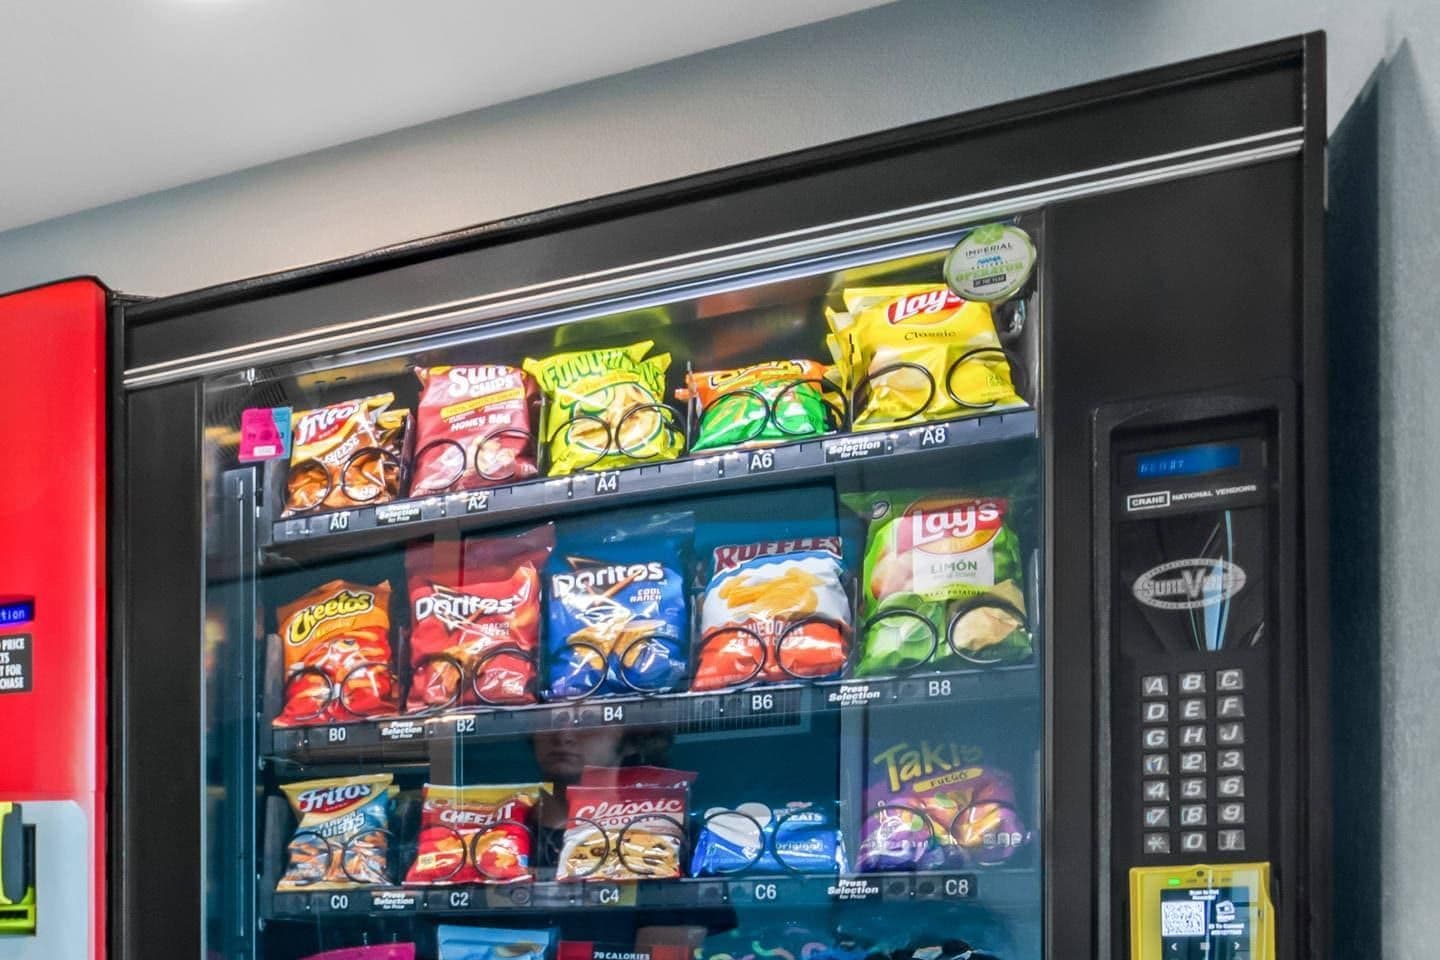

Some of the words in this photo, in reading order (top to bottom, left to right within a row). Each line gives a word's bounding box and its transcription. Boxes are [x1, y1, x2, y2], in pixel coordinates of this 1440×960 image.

[965, 242, 1013, 258] IMPERIAL
[922, 428, 945, 443] A8
[750, 454, 772, 469] A6
[598, 477, 617, 491] A4
[467, 496, 487, 510] A2
[1131, 494, 1166, 507] CRANE
[1171, 490, 1214, 502] NATIONAL
[1215, 484, 1258, 497] VENDORS
[330, 513, 348, 530] A0
[912, 500, 1001, 548] Lay's
[713, 537, 843, 576] RUFFLES
[929, 558, 978, 575] LIMÓN
[552, 562, 665, 599] Doritos
[415, 596, 514, 621] Doritos
[288, 590, 375, 647] Cheetos
[2, 638, 25, 651] PRICE
[5, 663, 22, 677] FOR
[928, 681, 951, 696] B8
[1147, 678, 1163, 693] A
[1183, 674, 1201, 690] B
[1221, 671, 1239, 687] C
[752, 695, 772, 709] B6
[829, 690, 880, 701] Selection
[604, 708, 622, 721] B4
[1147, 704, 1165, 720] D
[1185, 701, 1201, 717] E
[1222, 698, 1238, 714] F
[457, 719, 474, 732] B2
[329, 728, 346, 741] B0
[1146, 730, 1165, 746] G
[1184, 727, 1203, 743] H
[1220, 725, 1238, 741] J
[1187, 754, 1202, 769] 2
[1223, 752, 1240, 767] 3
[1148, 783, 1164, 798] 4
[1187, 780, 1201, 795] 5
[1223, 779, 1239, 794] 6
[297, 784, 372, 812] Fritos
[575, 799, 682, 820] Classic
[1150, 809, 1165, 824] 7
[1187, 807, 1202, 823] 8
[1223, 805, 1240, 820] 9
[1187, 834, 1203, 849] 0
[755, 885, 776, 899] C6
[827, 885, 879, 896] Selection
[946, 880, 968, 895] C8
[331, 896, 348, 909] C0
[450, 892, 469, 906] C2
[600, 889, 619, 902] C4
[605, 952, 650, 960] CALORIES
